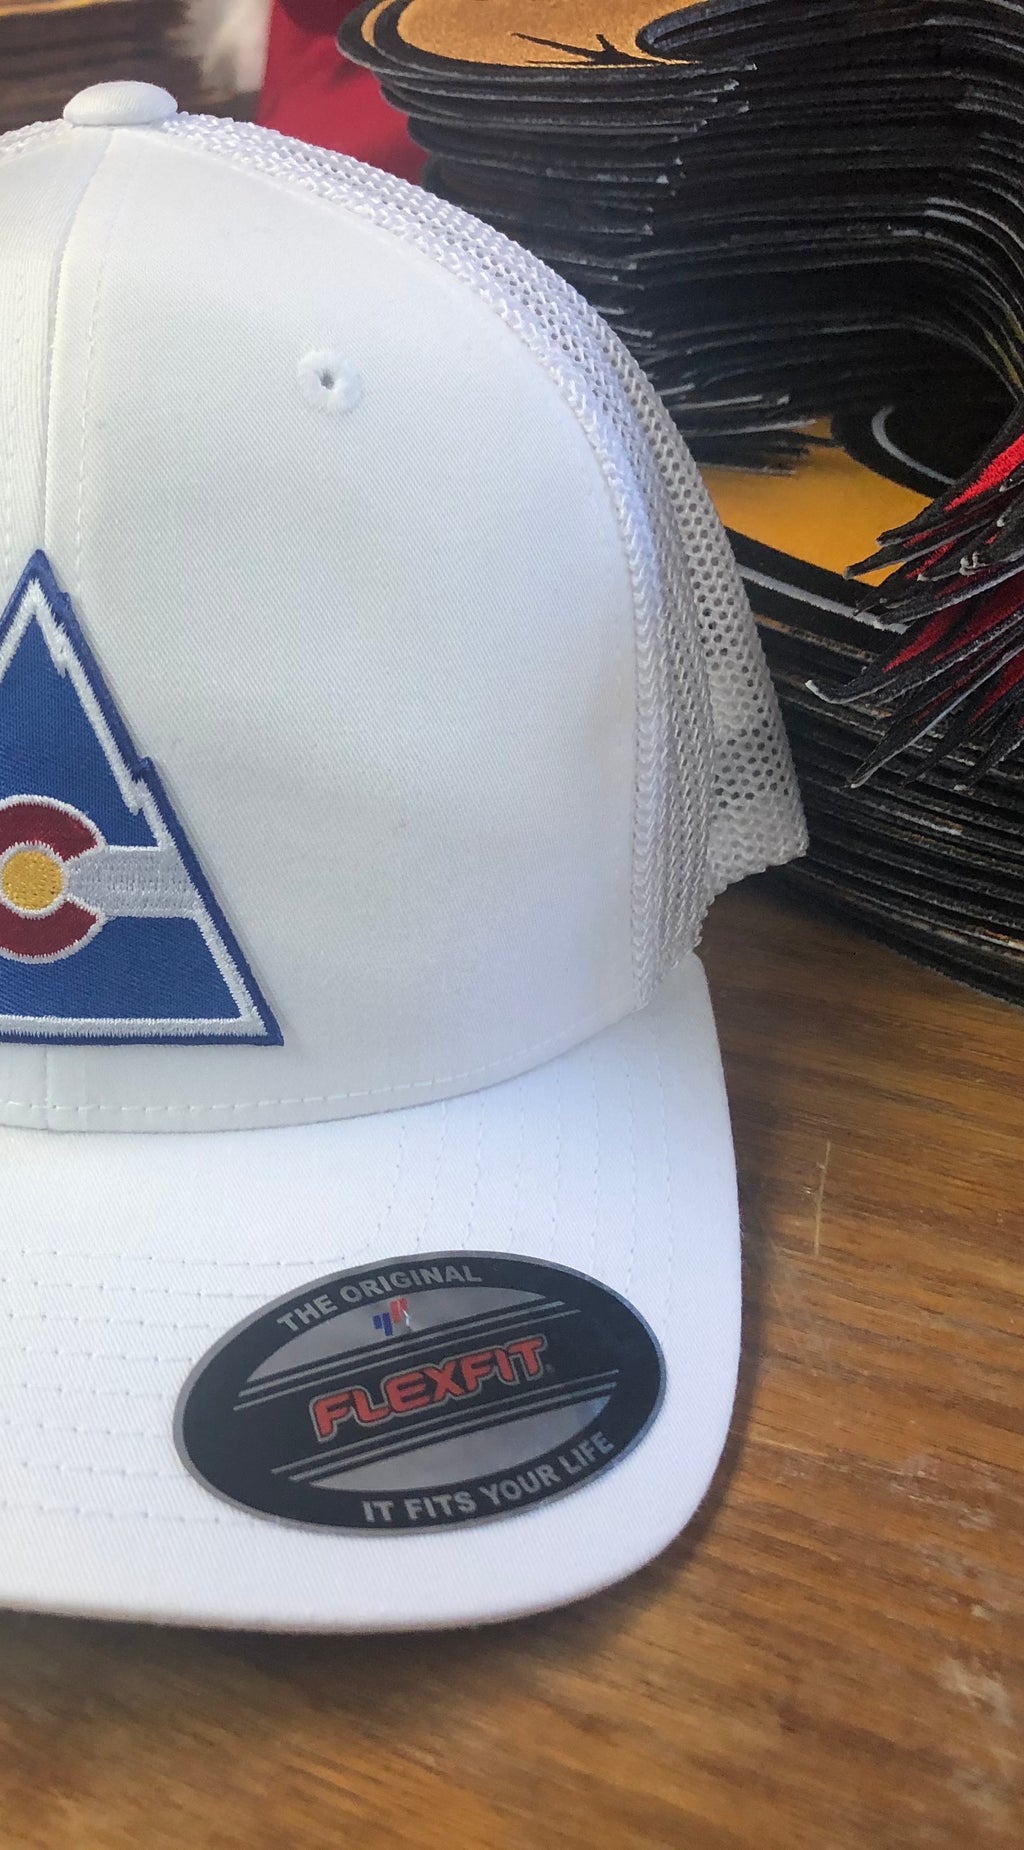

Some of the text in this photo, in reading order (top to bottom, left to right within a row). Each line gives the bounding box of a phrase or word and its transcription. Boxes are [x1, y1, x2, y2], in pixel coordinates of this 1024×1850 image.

[277, 1264, 482, 1332] THE ORIGINAL
[308, 1336, 548, 1443] FLEXFIT
[362, 1431, 615, 1523] IT FITS YOUR LIFE
